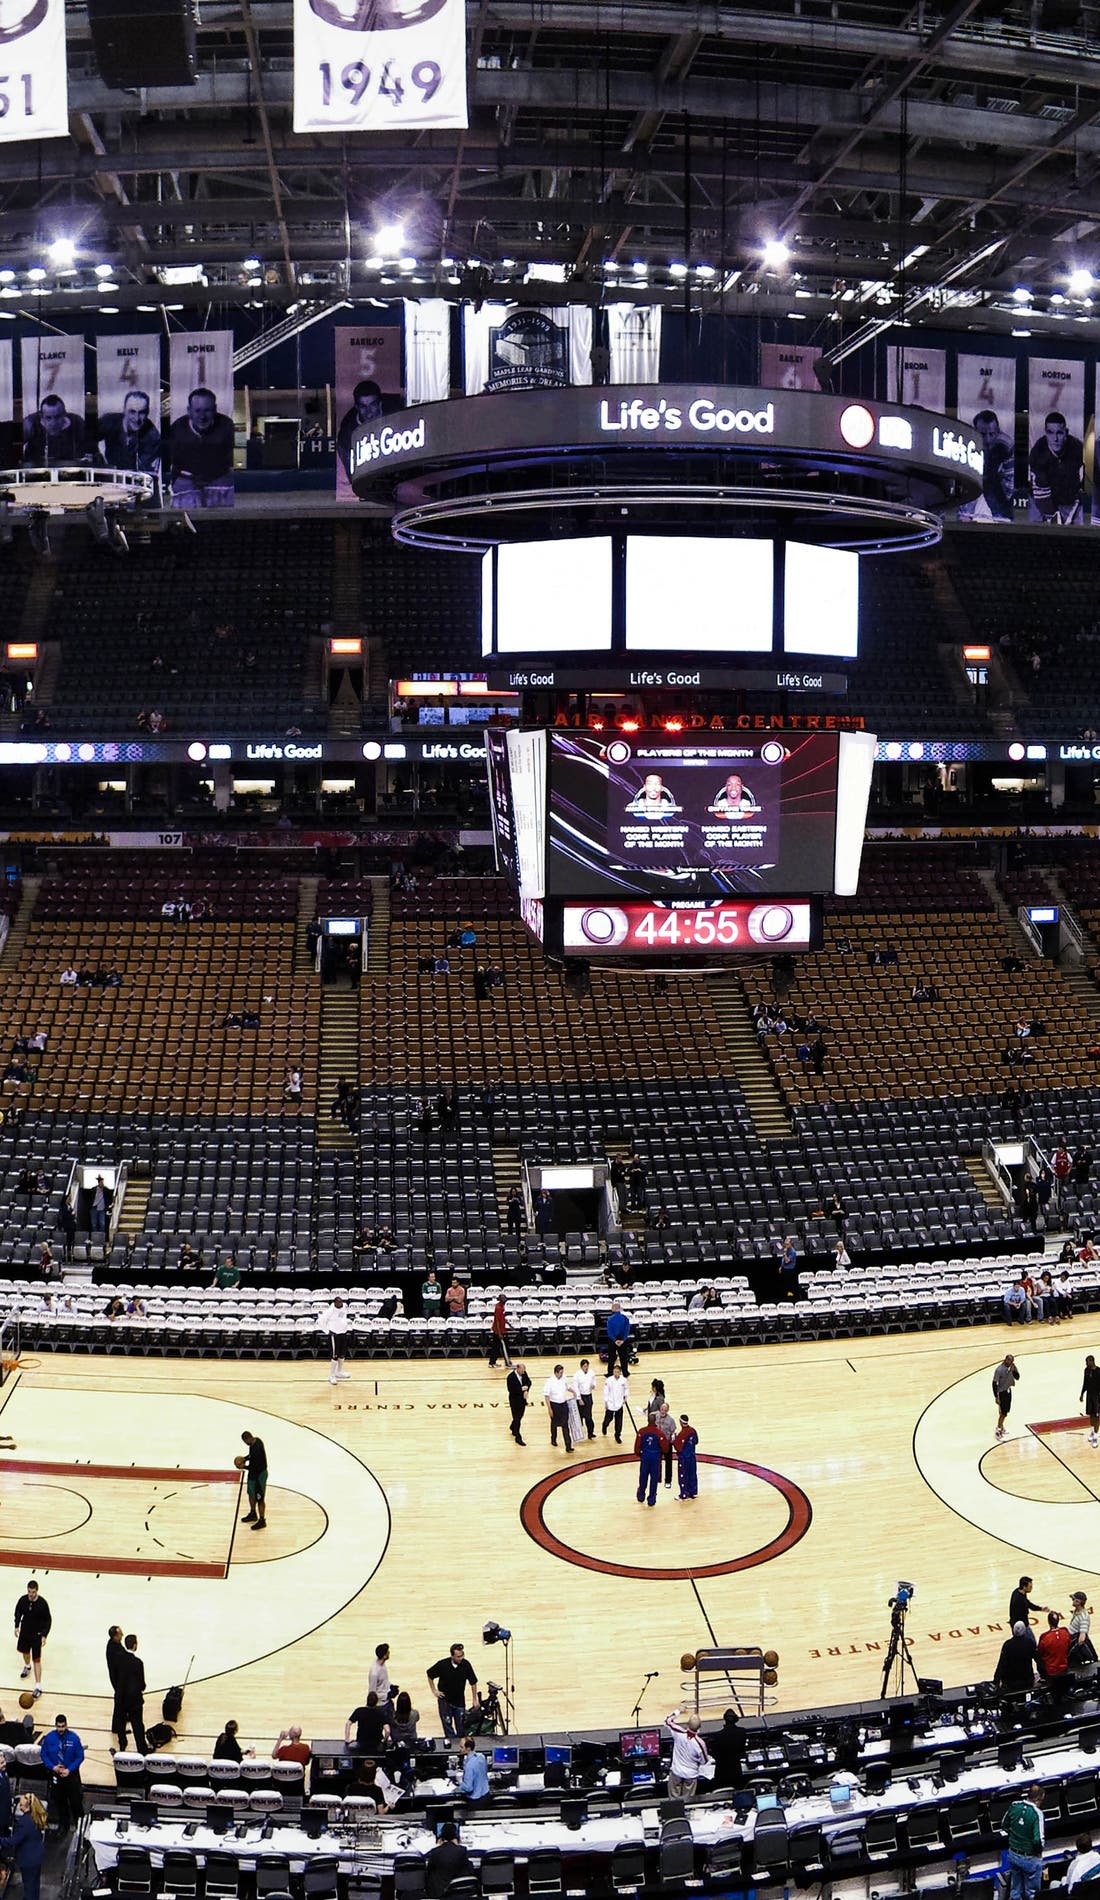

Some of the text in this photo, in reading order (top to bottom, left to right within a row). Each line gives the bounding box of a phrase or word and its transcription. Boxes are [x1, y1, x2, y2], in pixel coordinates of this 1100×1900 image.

[319, 58, 441, 106] 1949
[493, 367, 516, 377] MAPLE
[488, 376, 528, 392] MEMORIES
[601, 400, 774, 433] Life's Good
[356, 419, 425, 467] Life's Good
[933, 426, 967, 464] Life's
[509, 672, 554, 686] Life's Good
[630, 672, 701, 685] Life's Good
[777, 673, 822, 688] Life's Good
[736, 714, 836, 728] CENTRE
[247, 744, 323, 759] Life's Good
[422, 744, 457, 759] Life's
[637, 749, 754, 757] PLAYERS OF THE MONTH
[1060, 745, 1091, 759] Life's
[158, 834, 182, 845] 107
[704, 840, 763, 848] OF THE MONTH
[671, 901, 706, 909] PREGAME
[634, 911, 739, 945] 44:55
[333, 1403, 415, 1411] CENTRE
[927, 1617, 1039, 1642] CNADA
